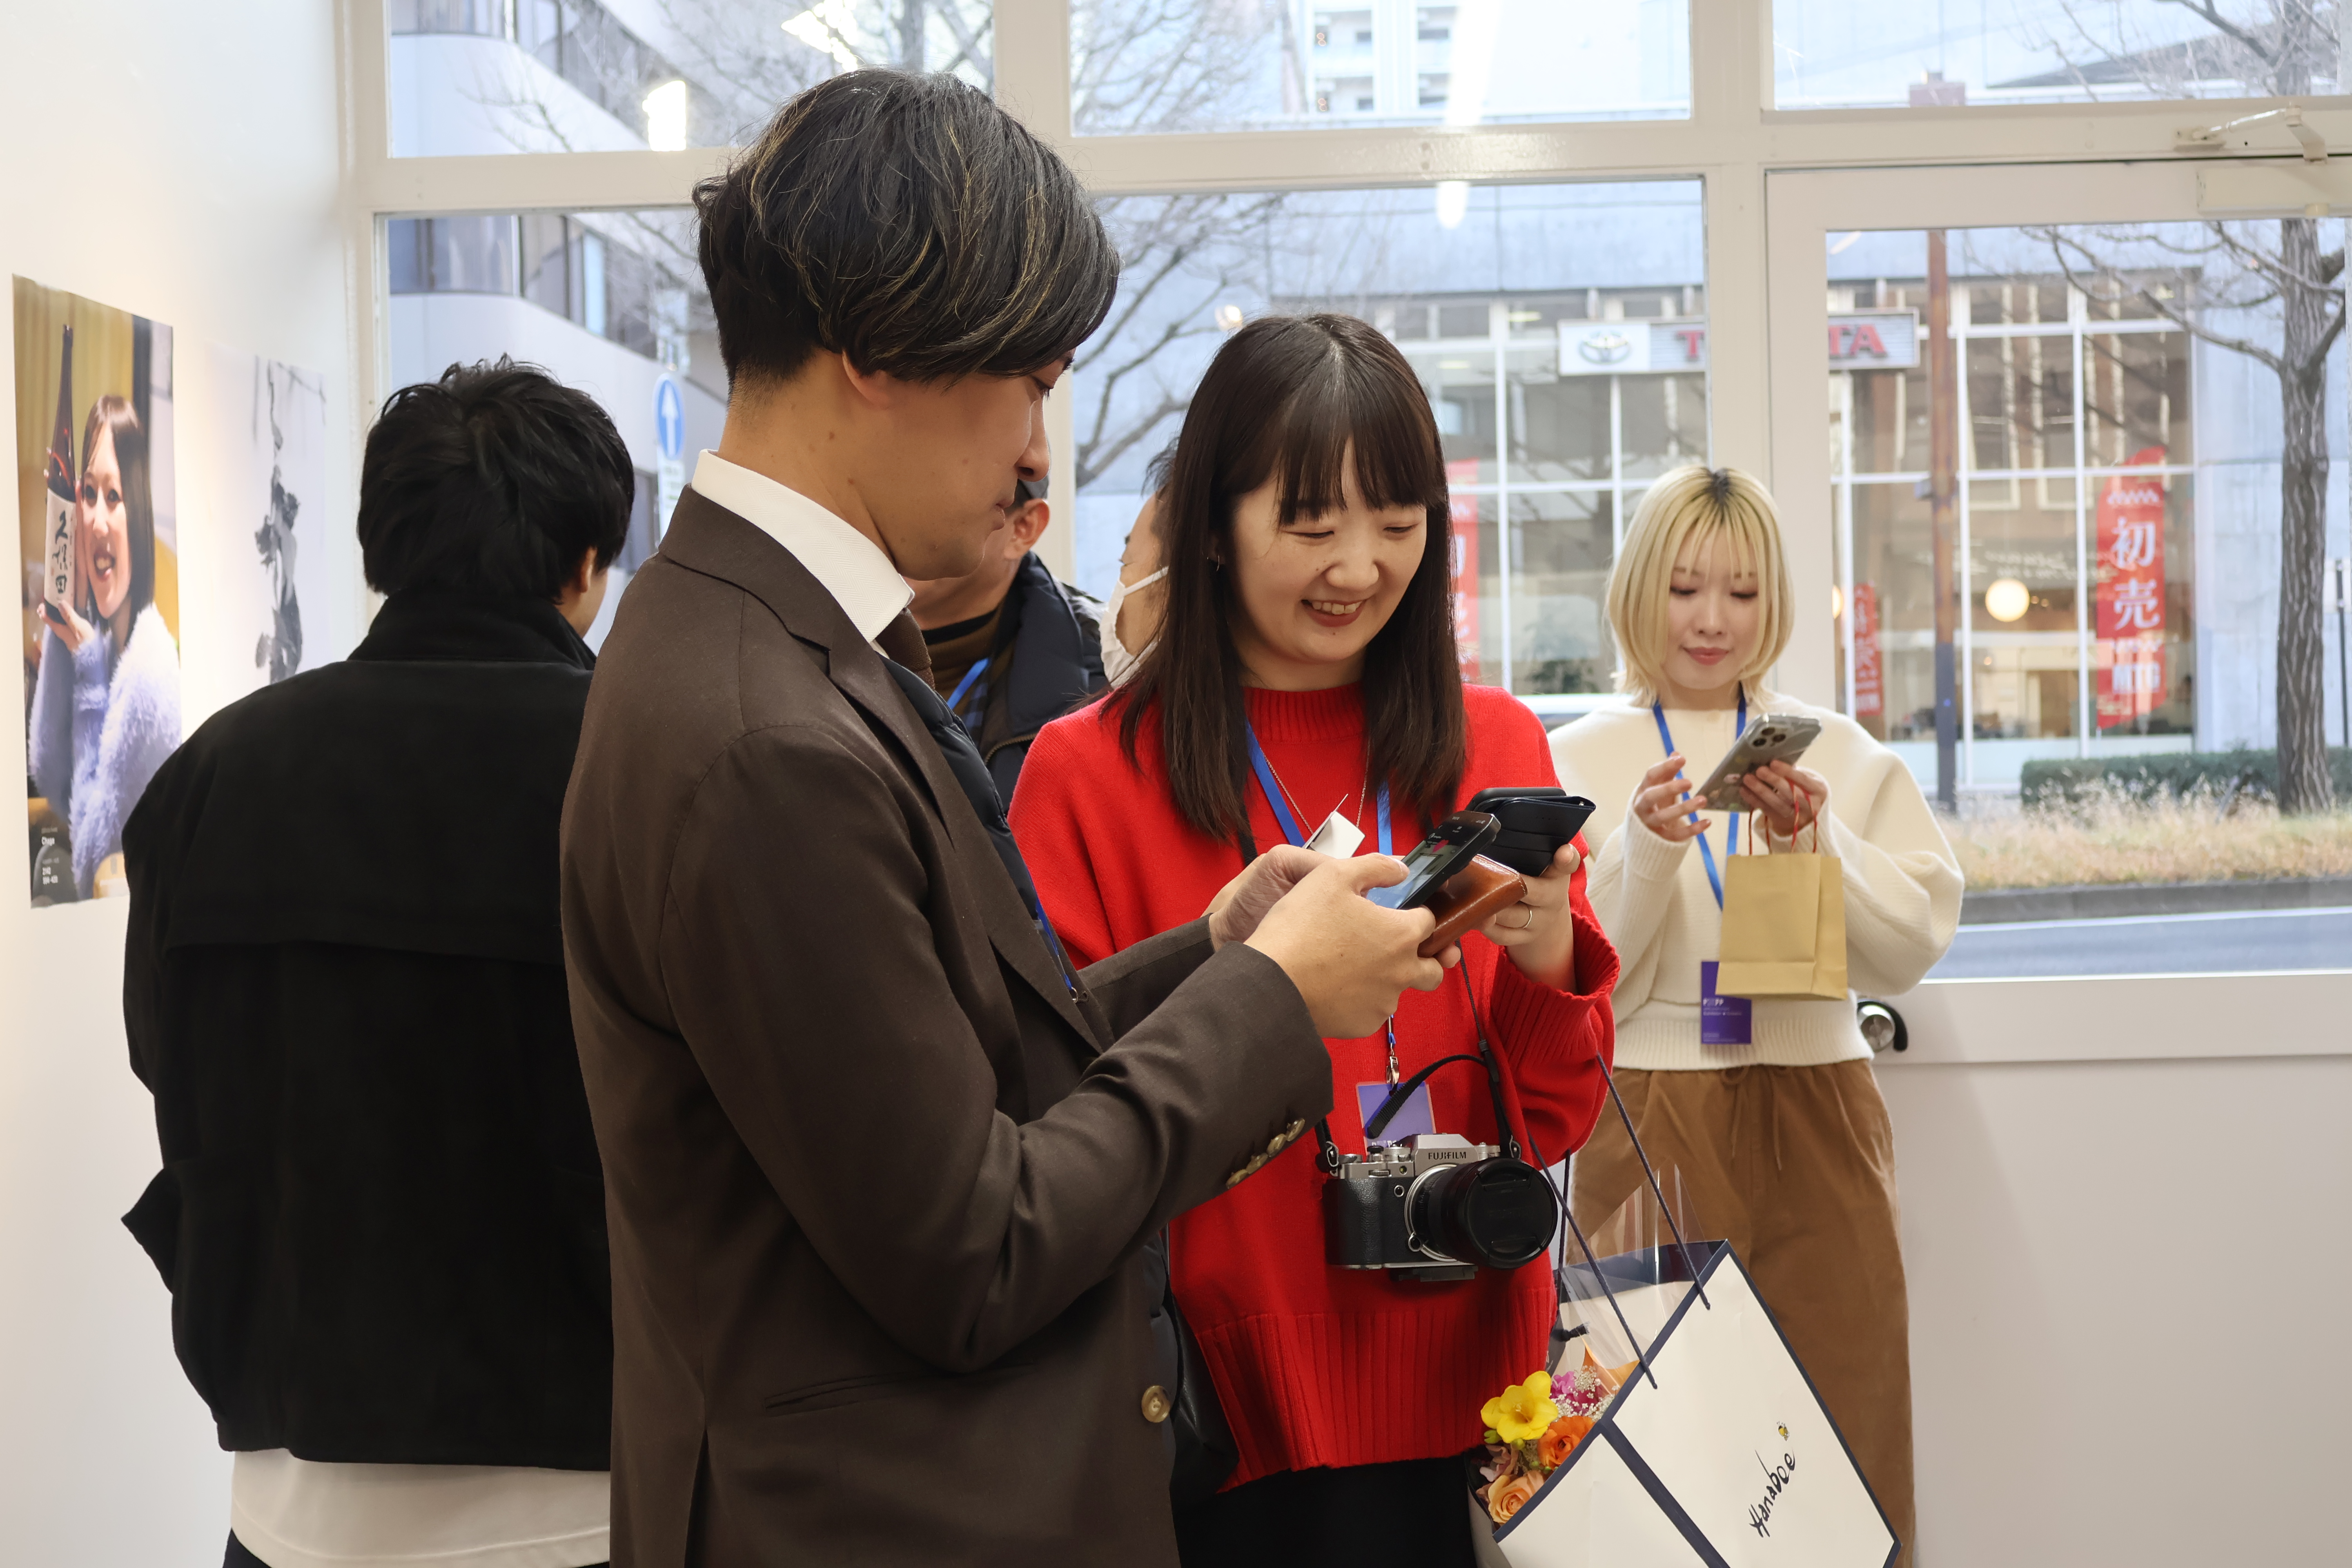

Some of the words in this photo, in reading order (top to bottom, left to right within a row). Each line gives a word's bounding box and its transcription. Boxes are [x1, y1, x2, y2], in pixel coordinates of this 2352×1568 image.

[52, 510, 68, 594] 久保田
[2110, 516, 2160, 630] 初売
[1428, 1151, 1466, 1160] FUJIFILM
